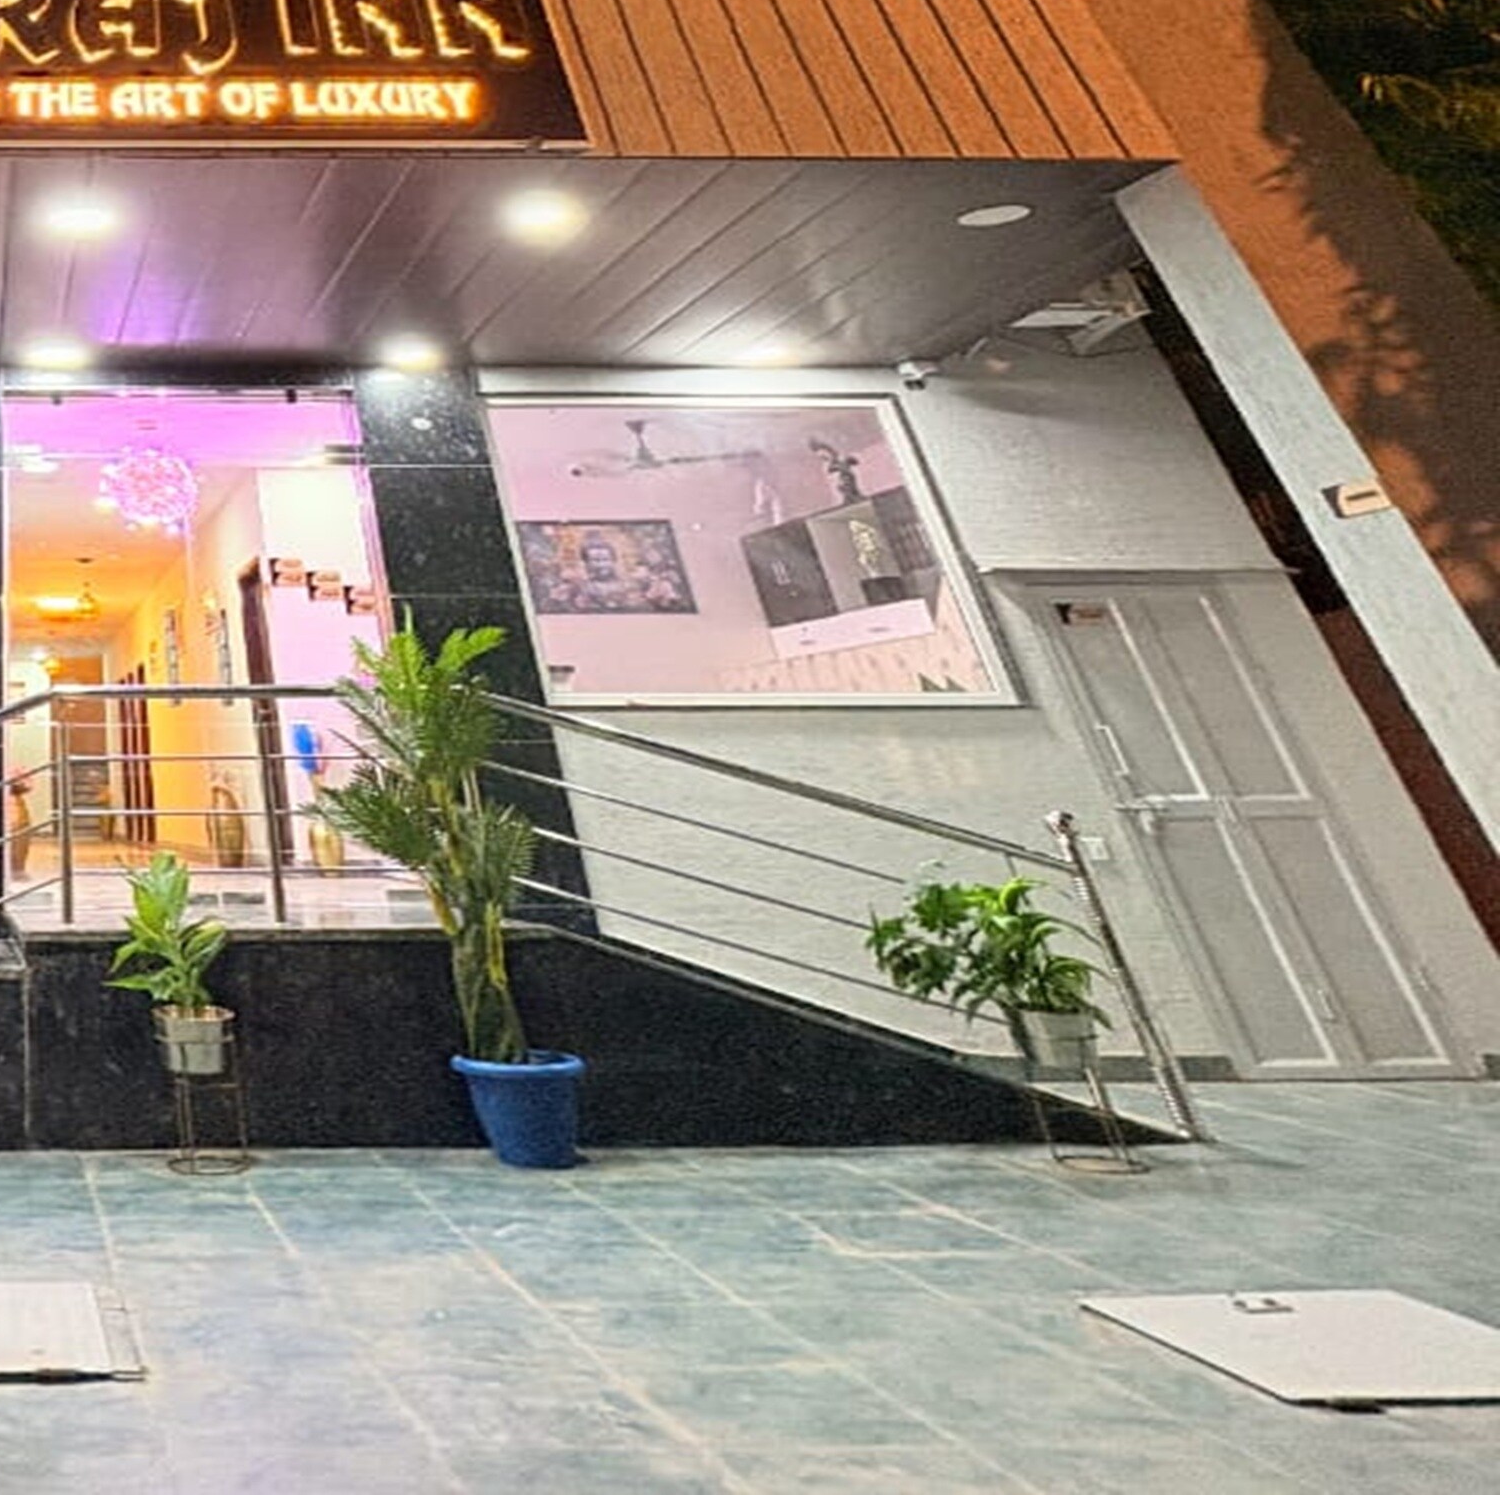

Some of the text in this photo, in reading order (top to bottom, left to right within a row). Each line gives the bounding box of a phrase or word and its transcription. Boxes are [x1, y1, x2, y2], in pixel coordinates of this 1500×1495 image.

[8, 82, 98, 119] THE
[109, 82, 207, 119] ART
[218, 82, 280, 119] OF
[290, 81, 477, 120] LUXURY
